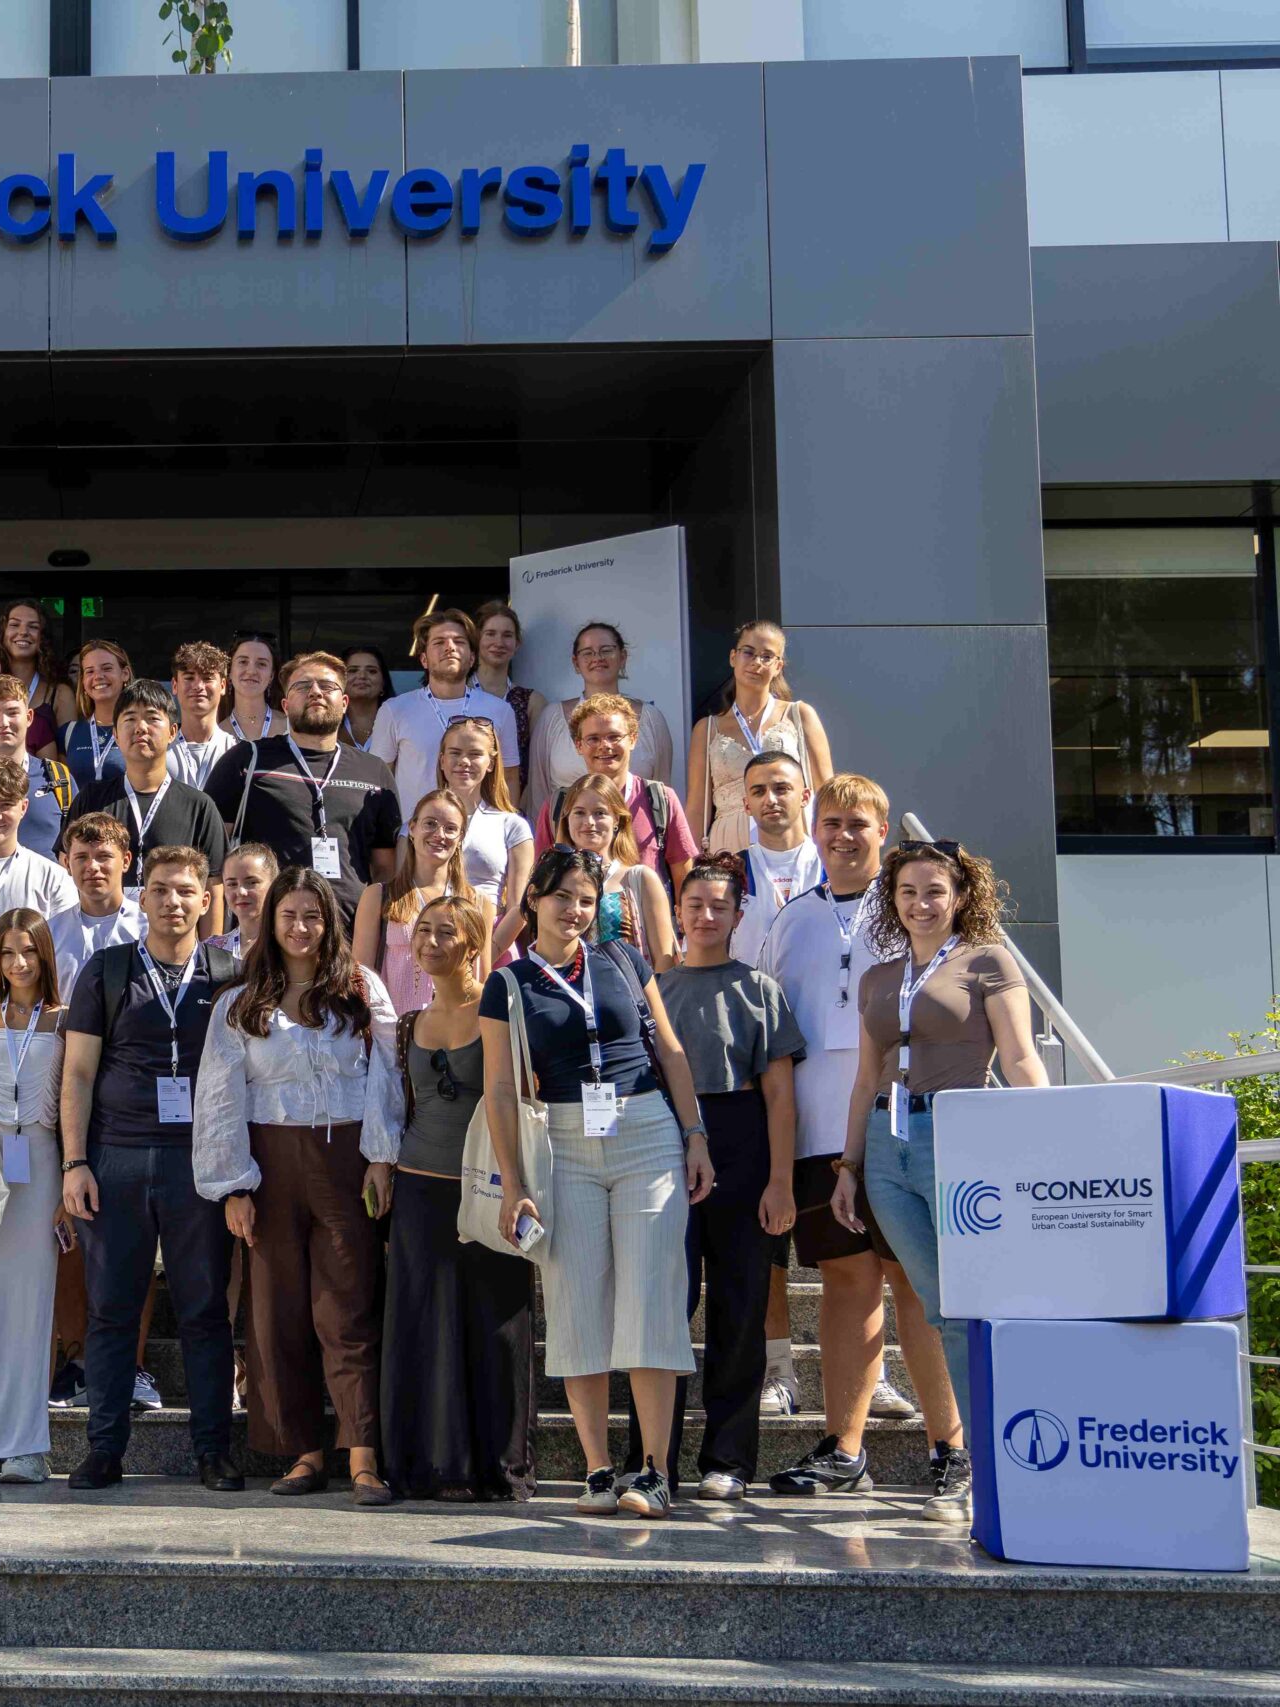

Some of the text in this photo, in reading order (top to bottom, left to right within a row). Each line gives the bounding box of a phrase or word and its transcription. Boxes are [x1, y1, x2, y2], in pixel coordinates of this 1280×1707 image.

[155, 143, 707, 253] University
[535, 558, 614, 579] Frederick University
[1031, 1209, 1153, 1222] European University for Smart
[1031, 1218, 1145, 1231] Urban Coastal Sustainability
[1078, 1416, 1230, 1445] Frederick
[1079, 1444, 1239, 1479] University
